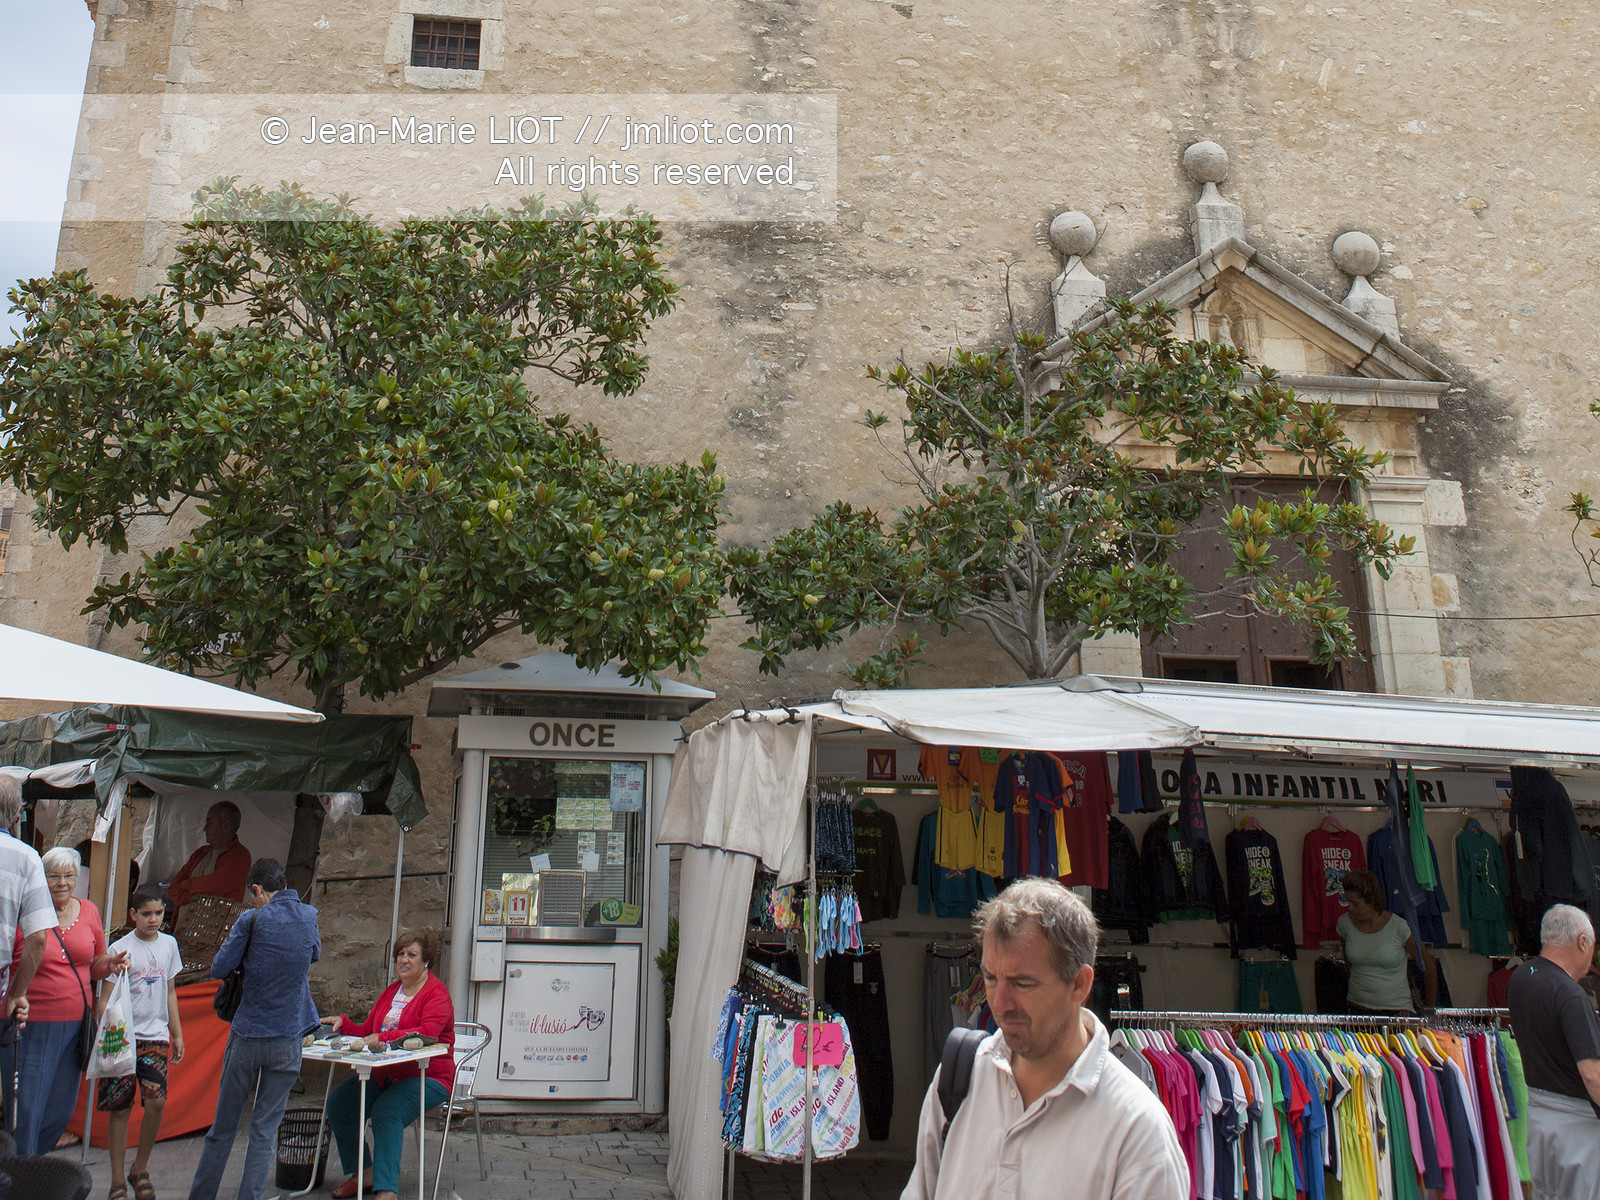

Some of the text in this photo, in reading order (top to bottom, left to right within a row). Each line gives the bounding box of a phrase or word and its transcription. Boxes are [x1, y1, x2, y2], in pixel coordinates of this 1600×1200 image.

[529, 722, 616, 747] ONCE
[1154, 768, 1222, 795] OA
[1231, 772, 1366, 800] INFANTIL
[1244, 846, 1262, 859] HIDE
[1321, 847, 1342, 859] HIDE
[1323, 859, 1352, 872] SNEAK
[511, 896, 526, 911] 11
[603, 900, 621, 918] +18
[826, 1077, 845, 1106] ISLAND
